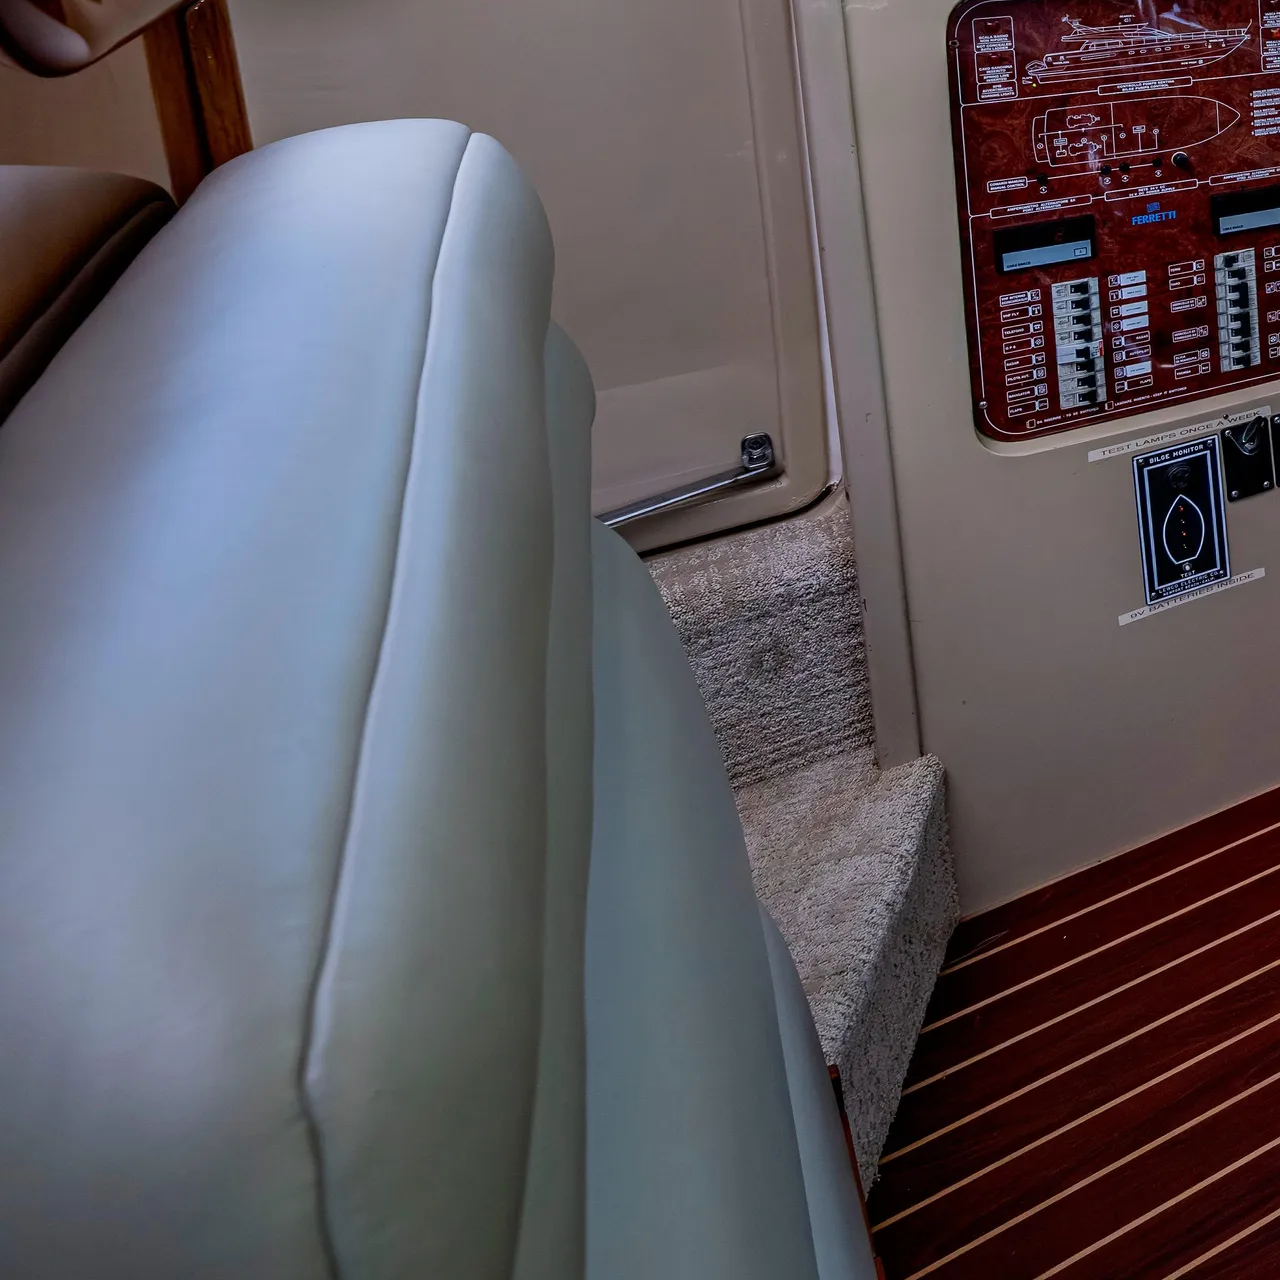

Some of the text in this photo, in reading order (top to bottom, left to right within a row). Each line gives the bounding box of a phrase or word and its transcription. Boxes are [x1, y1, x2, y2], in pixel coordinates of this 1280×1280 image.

[1131, 210, 1177, 226] FERRETTI
[1101, 410, 1261, 456] TEST LAMPS ONCE A WEEK
[1149, 444, 1204, 464] BILGE MONITOR
[1180, 570, 1195, 578] TEST
[1180, 574, 1208, 587] ELECTRIC
[1129, 572, 1255, 619] 9V BATTERIES INSIDE
